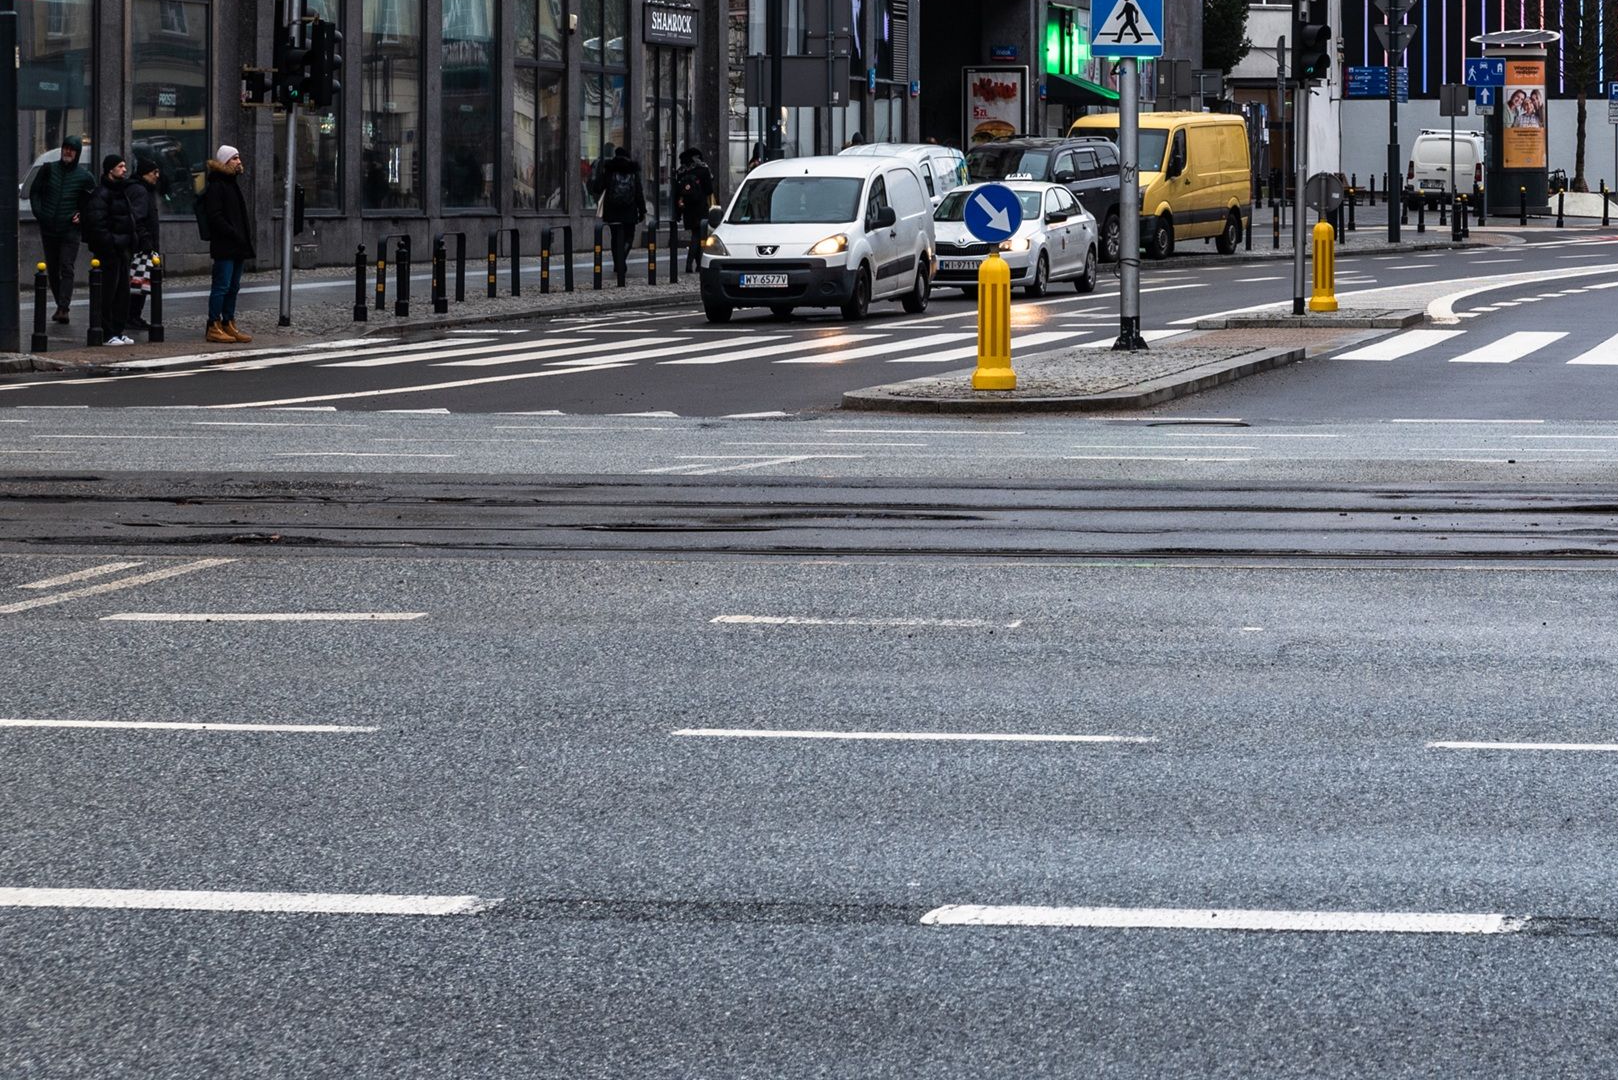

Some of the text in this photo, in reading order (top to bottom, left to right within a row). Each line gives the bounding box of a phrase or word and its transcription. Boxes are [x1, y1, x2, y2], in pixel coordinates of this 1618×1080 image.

[652, 11, 691, 33] SHAMROCK
[746, 275, 787, 284] WY 6577V
